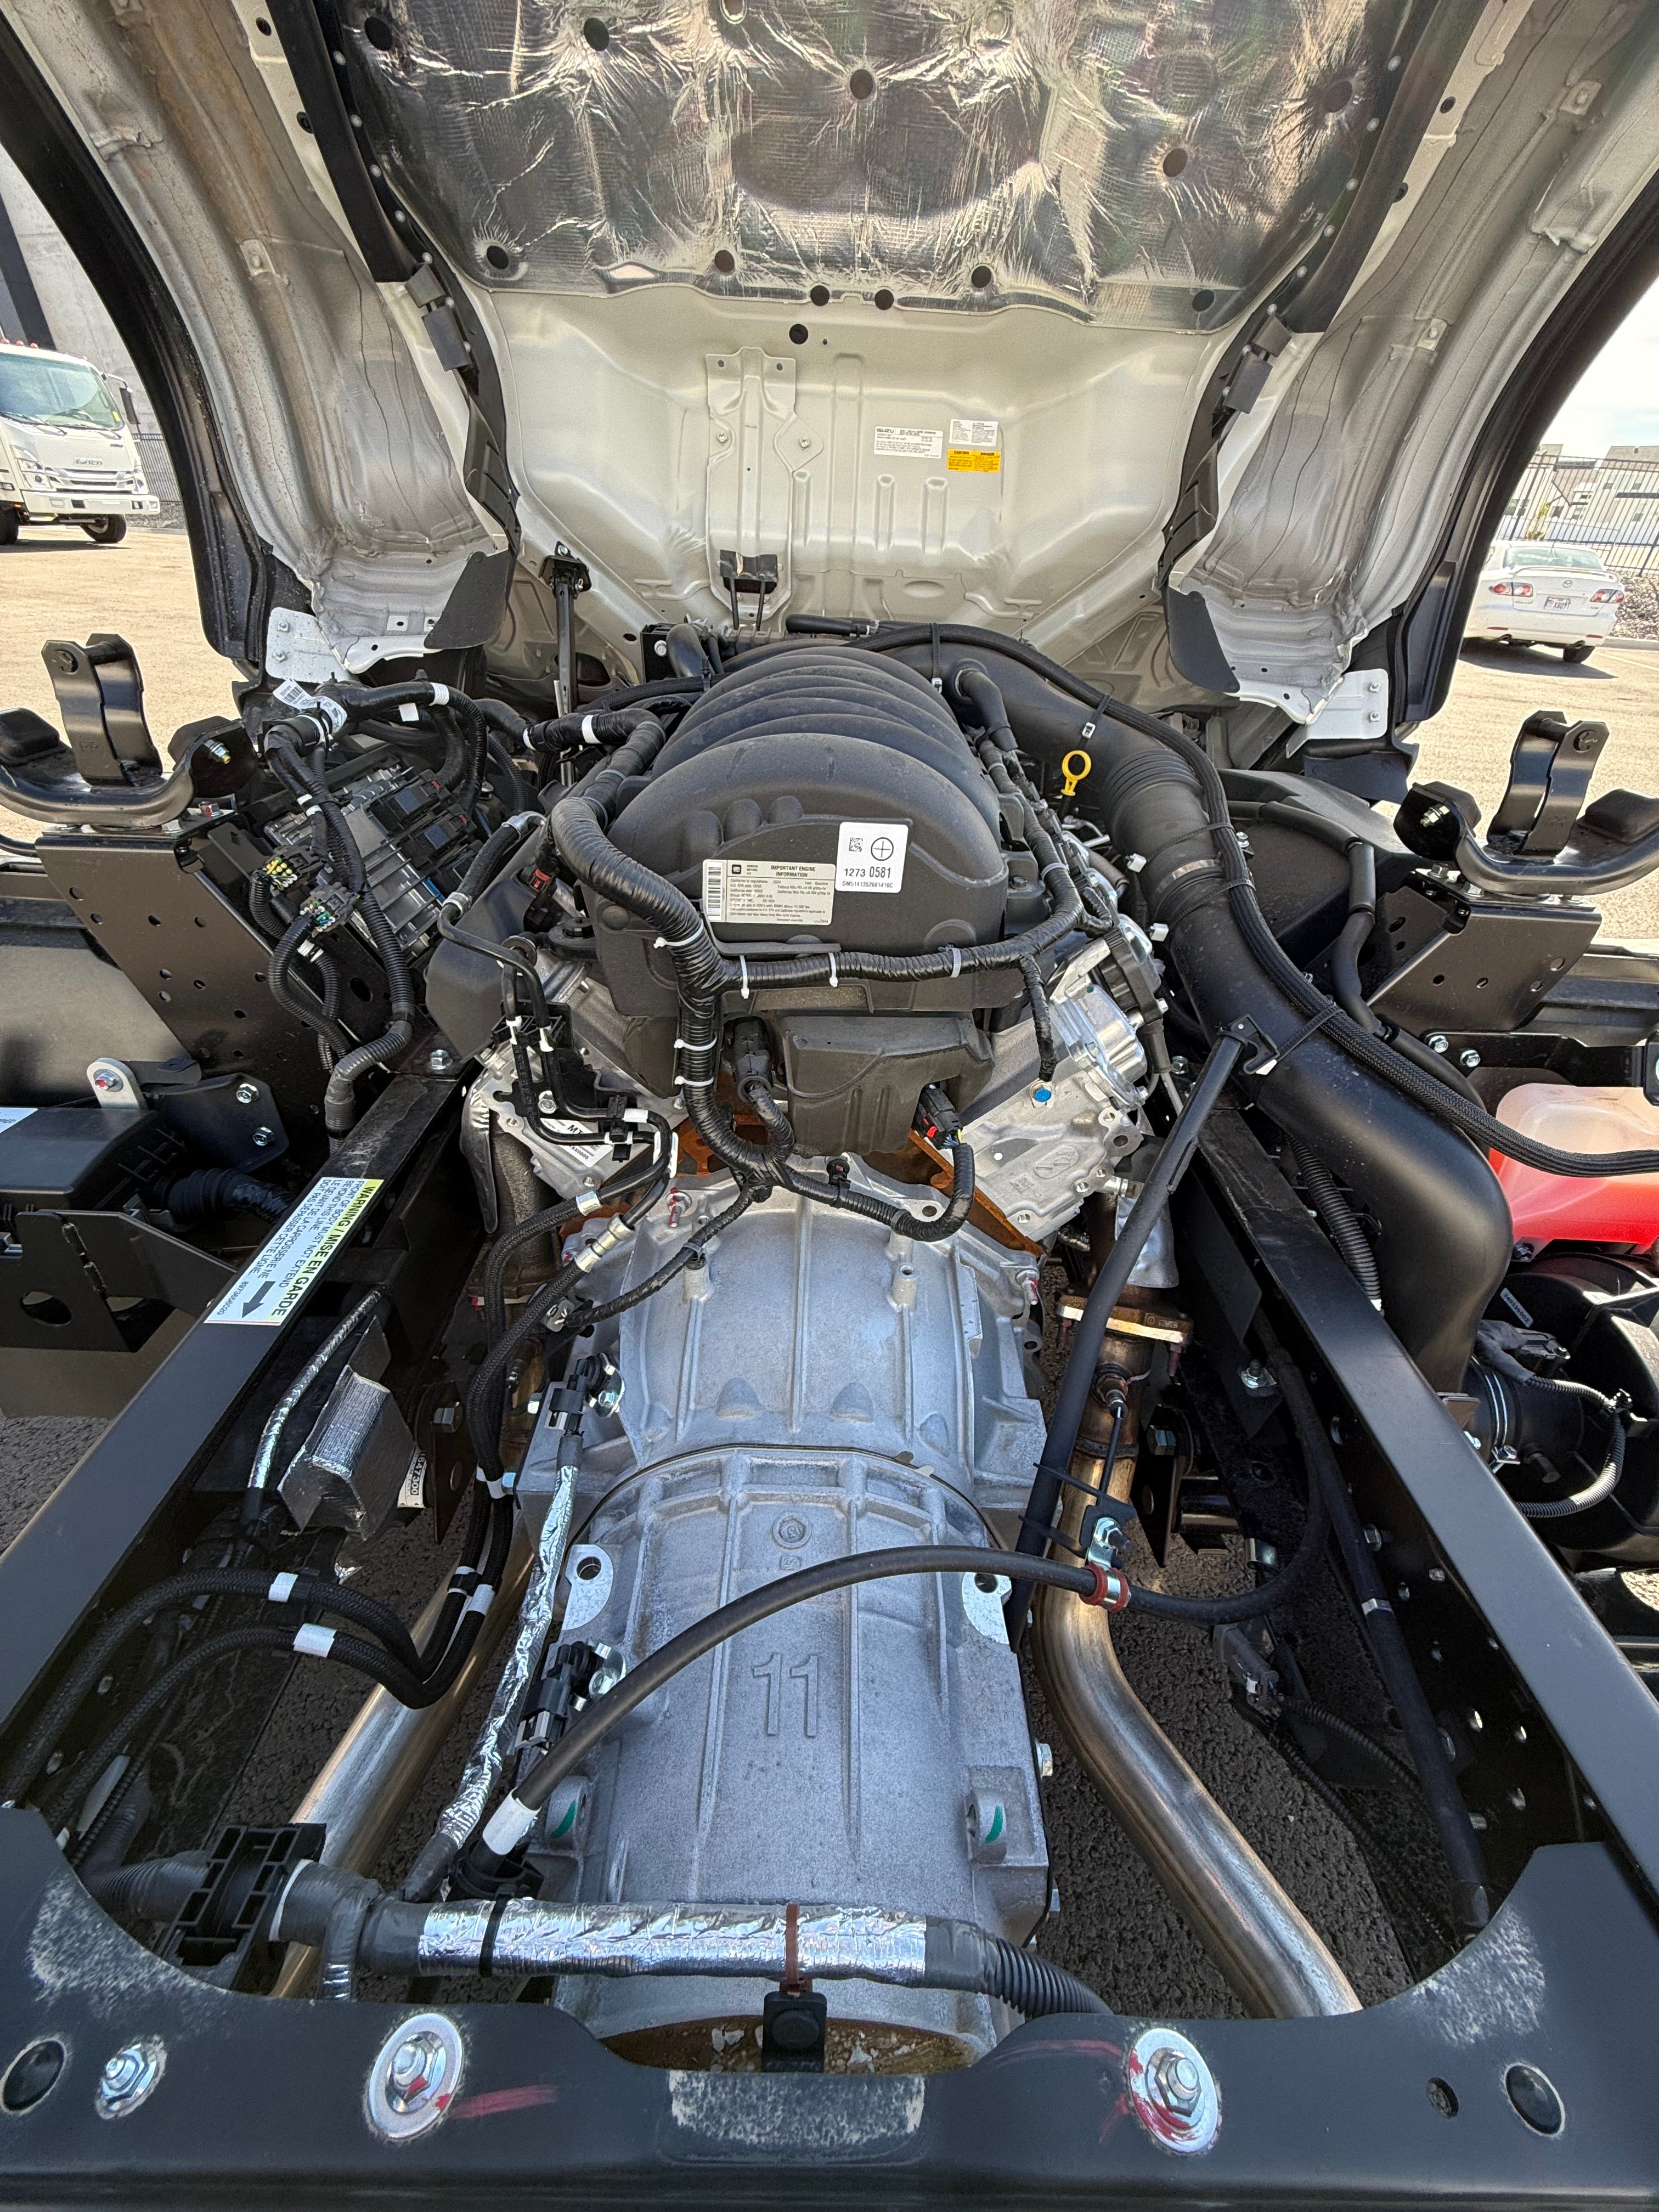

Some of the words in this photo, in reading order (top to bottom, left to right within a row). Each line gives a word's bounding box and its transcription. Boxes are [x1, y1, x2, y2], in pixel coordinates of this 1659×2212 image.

[844, 868, 866, 877] 1273
[869, 866, 891, 878] 0581
[317, 1179, 331, 1192] DOIT
[332, 1180, 354, 1202] BEYOND
[347, 1181, 365, 1199] FRONT
[307, 1192, 320, 1203] PAS
[315, 1187, 336, 1207] DEVANT
[338, 1200, 350, 1208] OF
[310, 1208, 320, 1216] DE
[320, 1203, 335, 1216] THIS
[337, 1186, 376, 1227] WARNING
[285, 1203, 313, 1232] DÉPASSER
[308, 1217, 324, 1232] LINE.
[326, 1209, 343, 1225] BODY
[266, 1233, 288, 1254] CETTE
[312, 1227, 331, 1244] MUST
[268, 1225, 307, 1268] CARROSSERIE
[301, 1245, 317, 1259] NOT
[314, 1234, 341, 1257] MISE
[248, 1254, 267, 1276] LIGNE.
[302, 1260, 322, 1274] EN
[257, 1269, 273, 1279] NE
[279, 1260, 306, 1288] EXTEND
[271, 1277, 309, 1316] GARDE
[751, 1651, 819, 1739] 11
